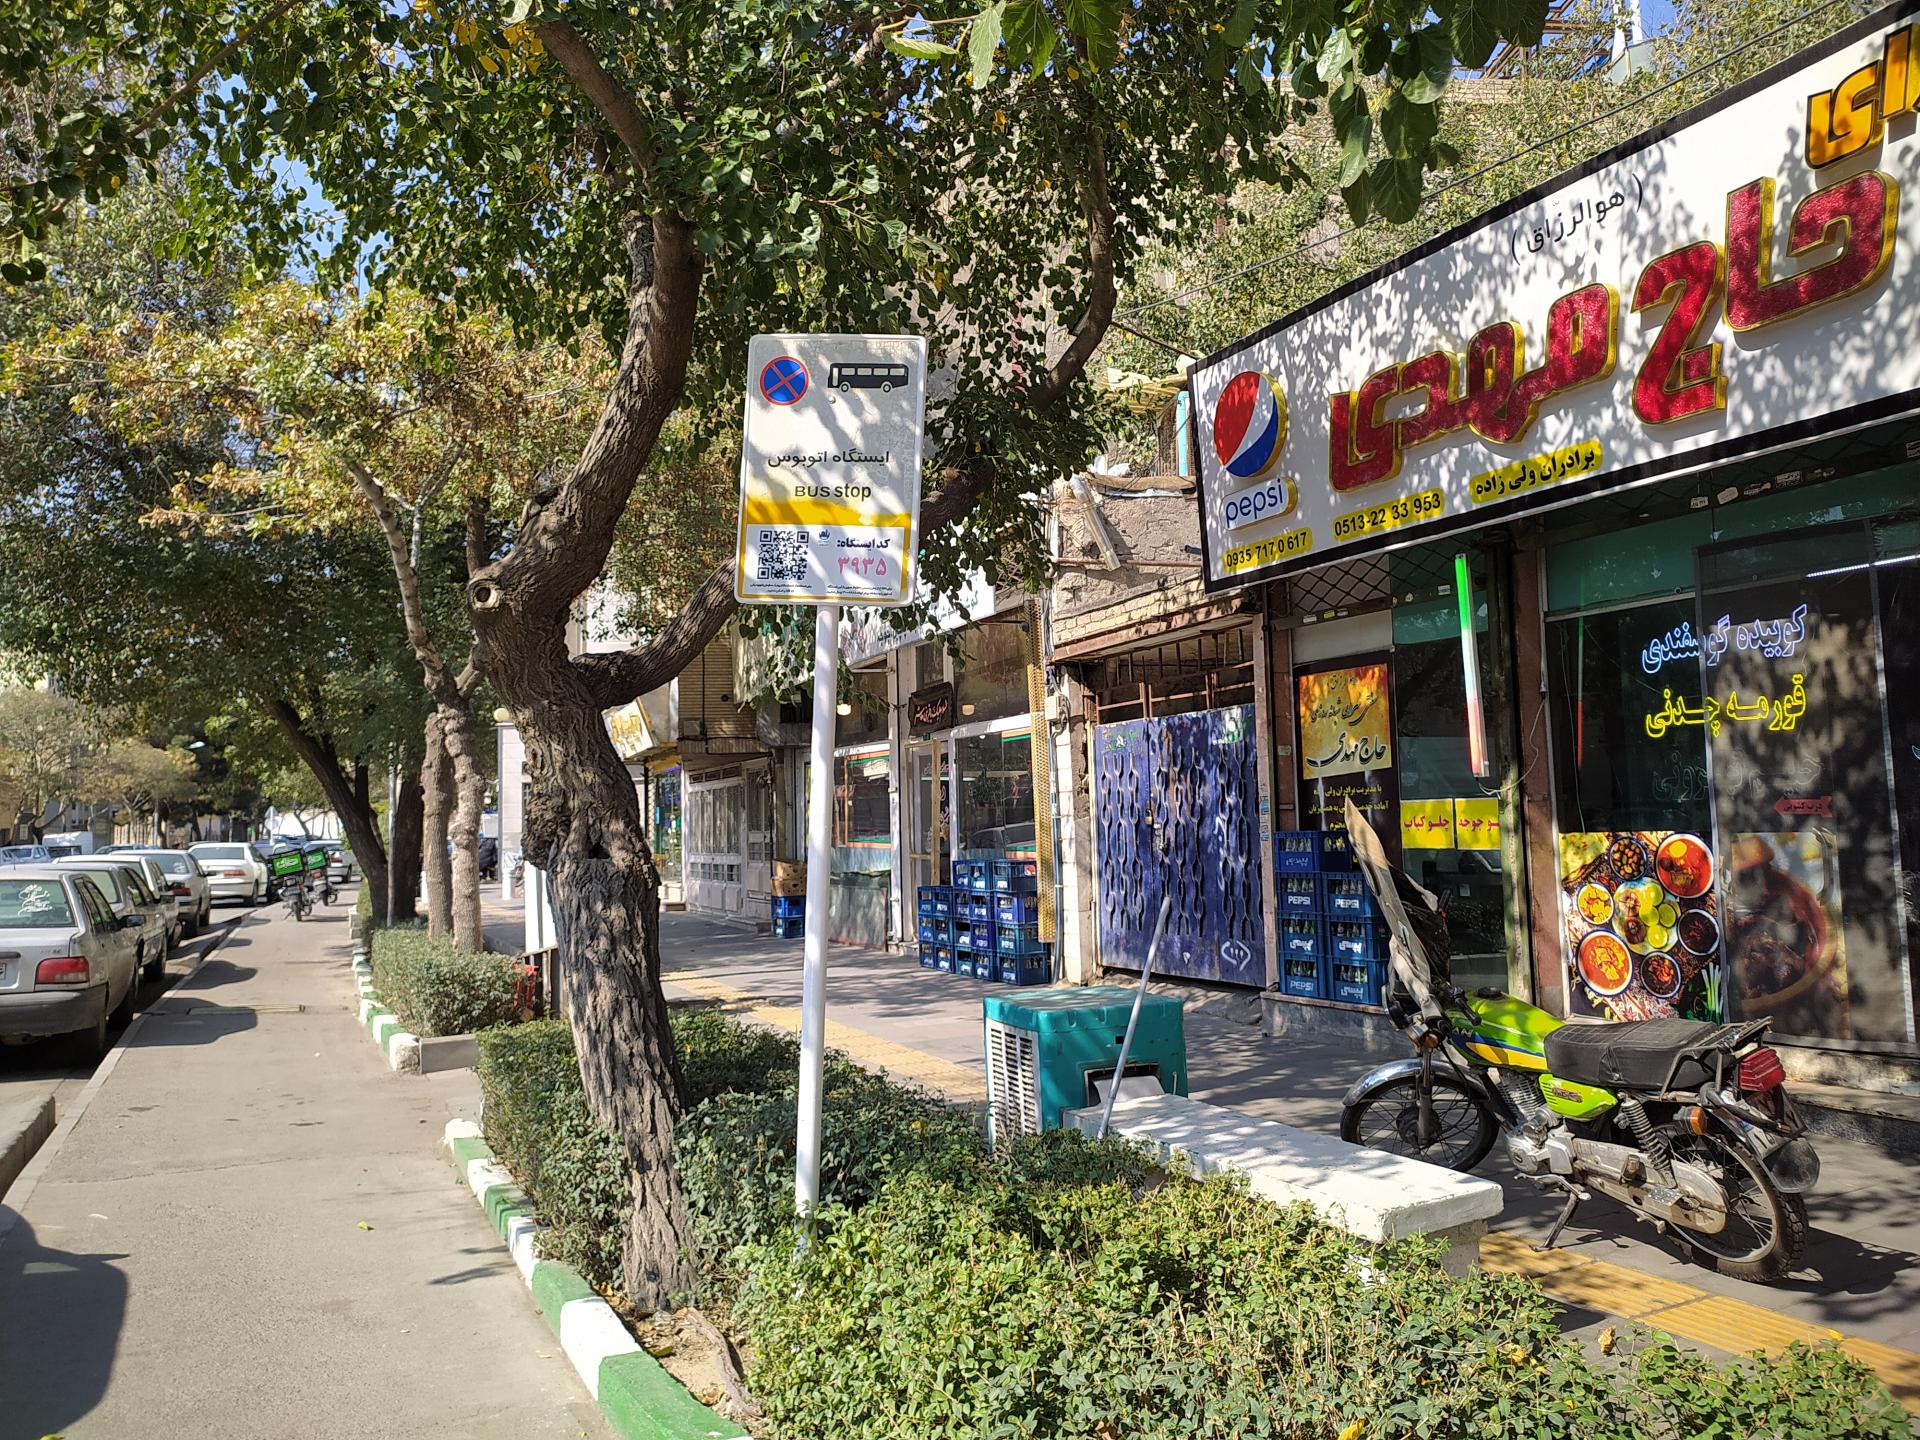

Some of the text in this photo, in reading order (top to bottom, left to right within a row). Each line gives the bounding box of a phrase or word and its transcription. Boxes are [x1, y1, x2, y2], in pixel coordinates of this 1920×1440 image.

[1328, 170, 1899, 493] حاج مهدی
[767, 448, 889, 468] ایستگاه اتوبوس
[1476, 449, 1595, 495] برادران ولی زاده
[794, 483, 872, 501] BUS stop
[1225, 478, 1284, 528] pepsi
[1334, 492, 1441, 537] 0513-22 33 953
[837, 537, 891, 551] کد ایستگاه:
[837, 556, 887, 576] ۳۹۳۵
[1226, 551, 1252, 568] 0935
[1642, 603, 1807, 673] کوبیده گوسفندی
[1726, 674, 1807, 730] قورمه
[1306, 732, 1387, 768] حاج مهدی
[1404, 815, 1449, 832] چلو کباب
[1459, 817, 1483, 832] جوجه
[1288, 895, 1311, 905] PEPSI
[1335, 898, 1359, 908] PEPSI
[1290, 981, 1313, 991] PEPSI
[1341, 985, 1363, 1000] پپسی
